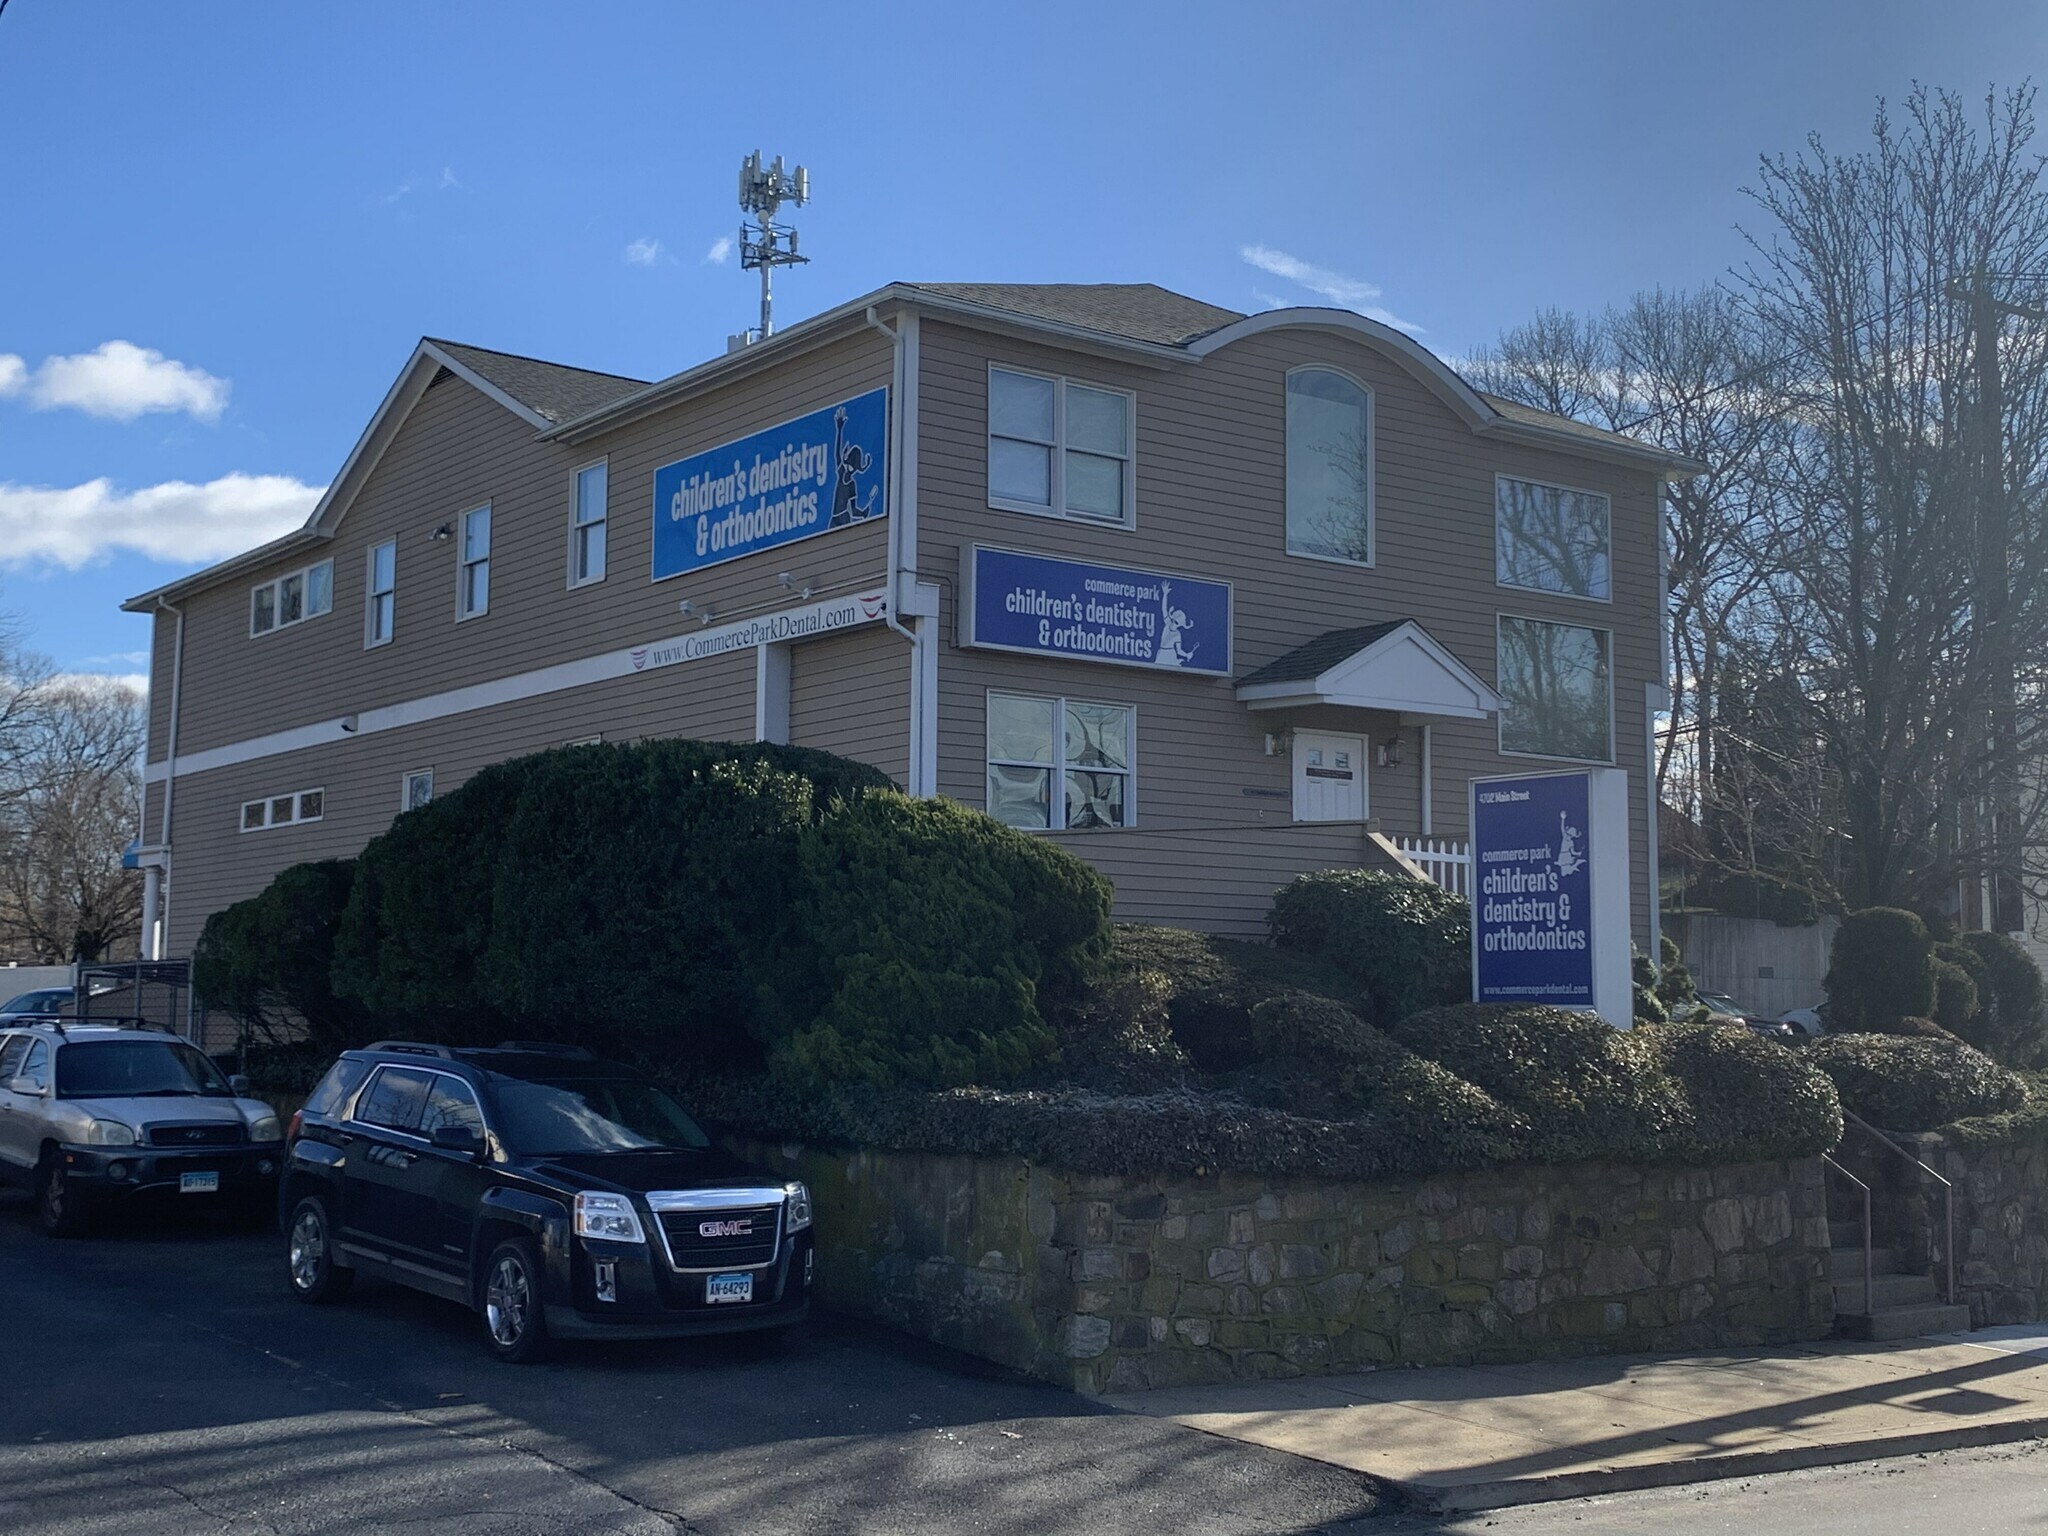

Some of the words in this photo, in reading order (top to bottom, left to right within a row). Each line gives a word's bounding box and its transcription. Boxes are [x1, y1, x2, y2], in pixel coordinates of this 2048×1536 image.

[671, 459, 747, 522] children's
[750, 443, 828, 497] dentistry
[696, 514, 708, 557] &
[711, 486, 818, 553] orthodontics
[1085, 578, 1136, 598] commerce
[1137, 585, 1160, 603] park
[1006, 587, 1083, 622] children's
[1086, 598, 1156, 637] dentistry
[653, 606, 856, 666] www.CommerceParkDental.com
[1038, 619, 1051, 647] &
[1053, 626, 1152, 659] orthodontics
[1495, 791, 1510, 802] Main
[1510, 790, 1530, 801] Street
[1482, 847, 1528, 863] commerce
[1530, 844, 1552, 864] park
[1483, 864, 1559, 895] children's
[1483, 896, 1556, 927] dentistry
[1559, 893, 1571, 922] &
[1483, 924, 1586, 952] orthodontics
[1483, 983, 1588, 997] www.commerceparkdental.com
[699, 1220, 752, 1237] GMC
[710, 1281, 750, 1296] AN-64293
